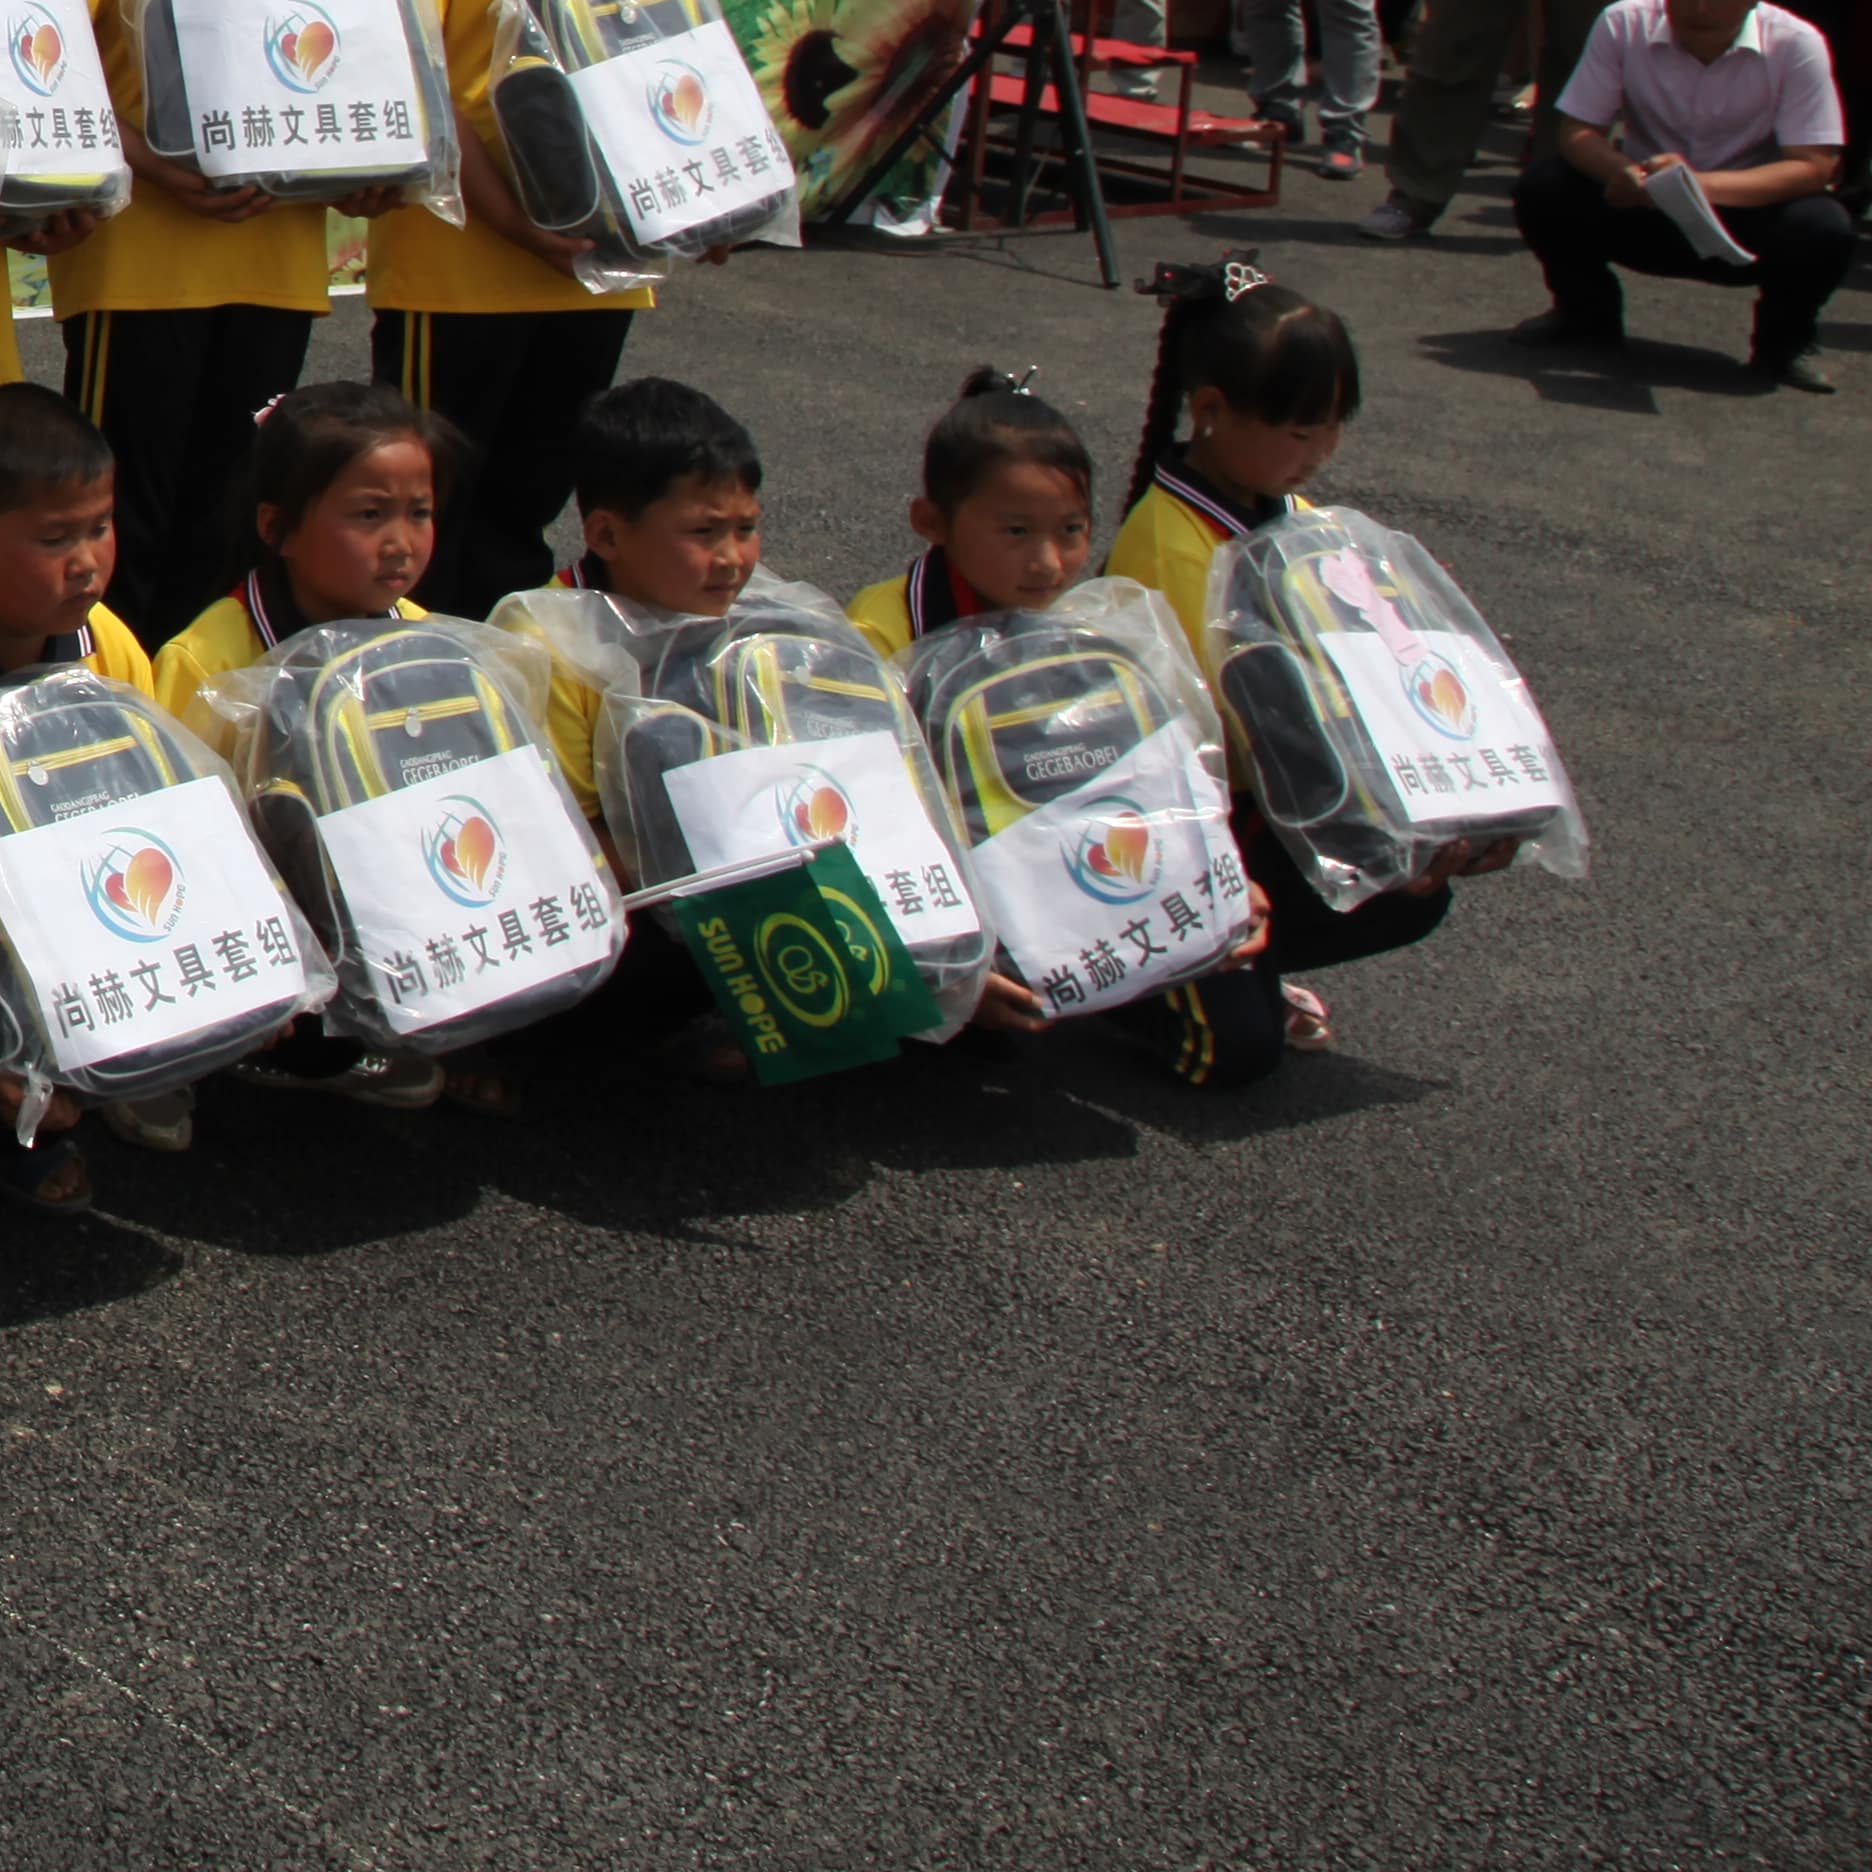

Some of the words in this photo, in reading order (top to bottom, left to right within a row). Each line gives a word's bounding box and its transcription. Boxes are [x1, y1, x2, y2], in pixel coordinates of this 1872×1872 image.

[202, 99, 414, 154] 尚赫文具套组
[53, 915, 298, 1038] 尚赫文具套组
[382, 882, 608, 1004] 尚赫文具套组
